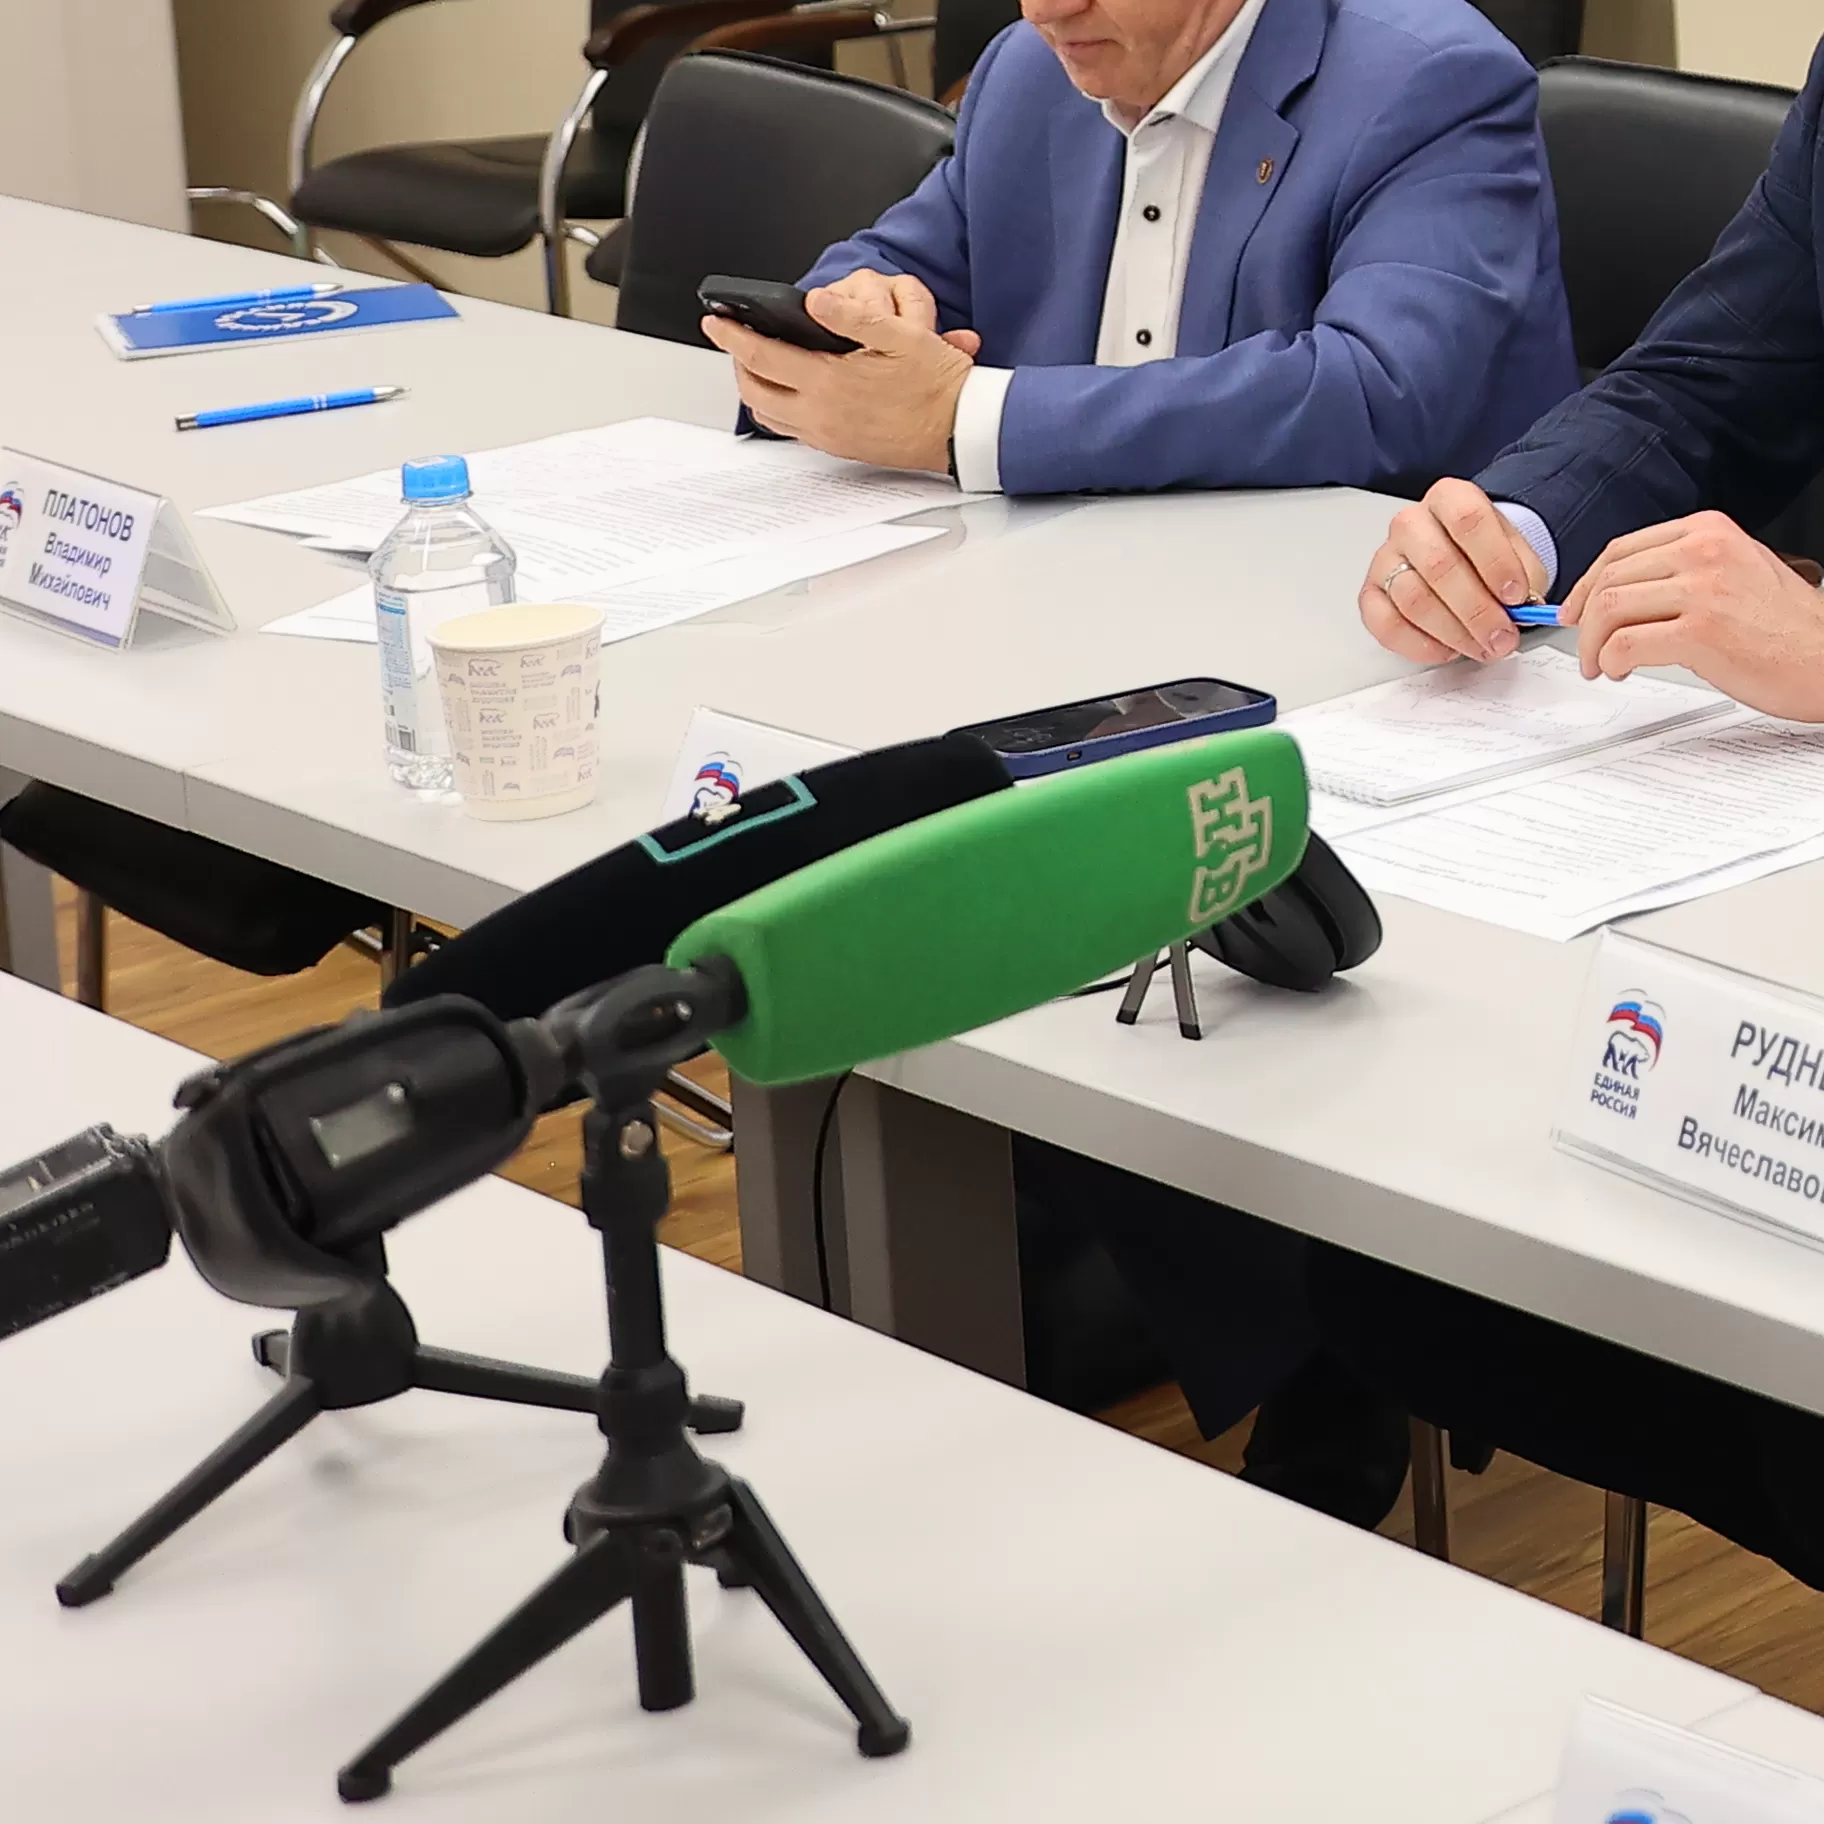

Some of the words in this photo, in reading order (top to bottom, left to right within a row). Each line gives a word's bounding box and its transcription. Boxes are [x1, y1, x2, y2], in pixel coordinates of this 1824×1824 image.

[42, 489, 135, 541] ПЛАТОНОВ
[44, 532, 112, 578] Владимир
[28, 562, 111, 610] Михайлович
[1187, 766, 1273, 923] НТВ
[1590, 1089, 1638, 1120] РОССИЯ
[1593, 1072, 1641, 1101] ЕДИНАЯ
